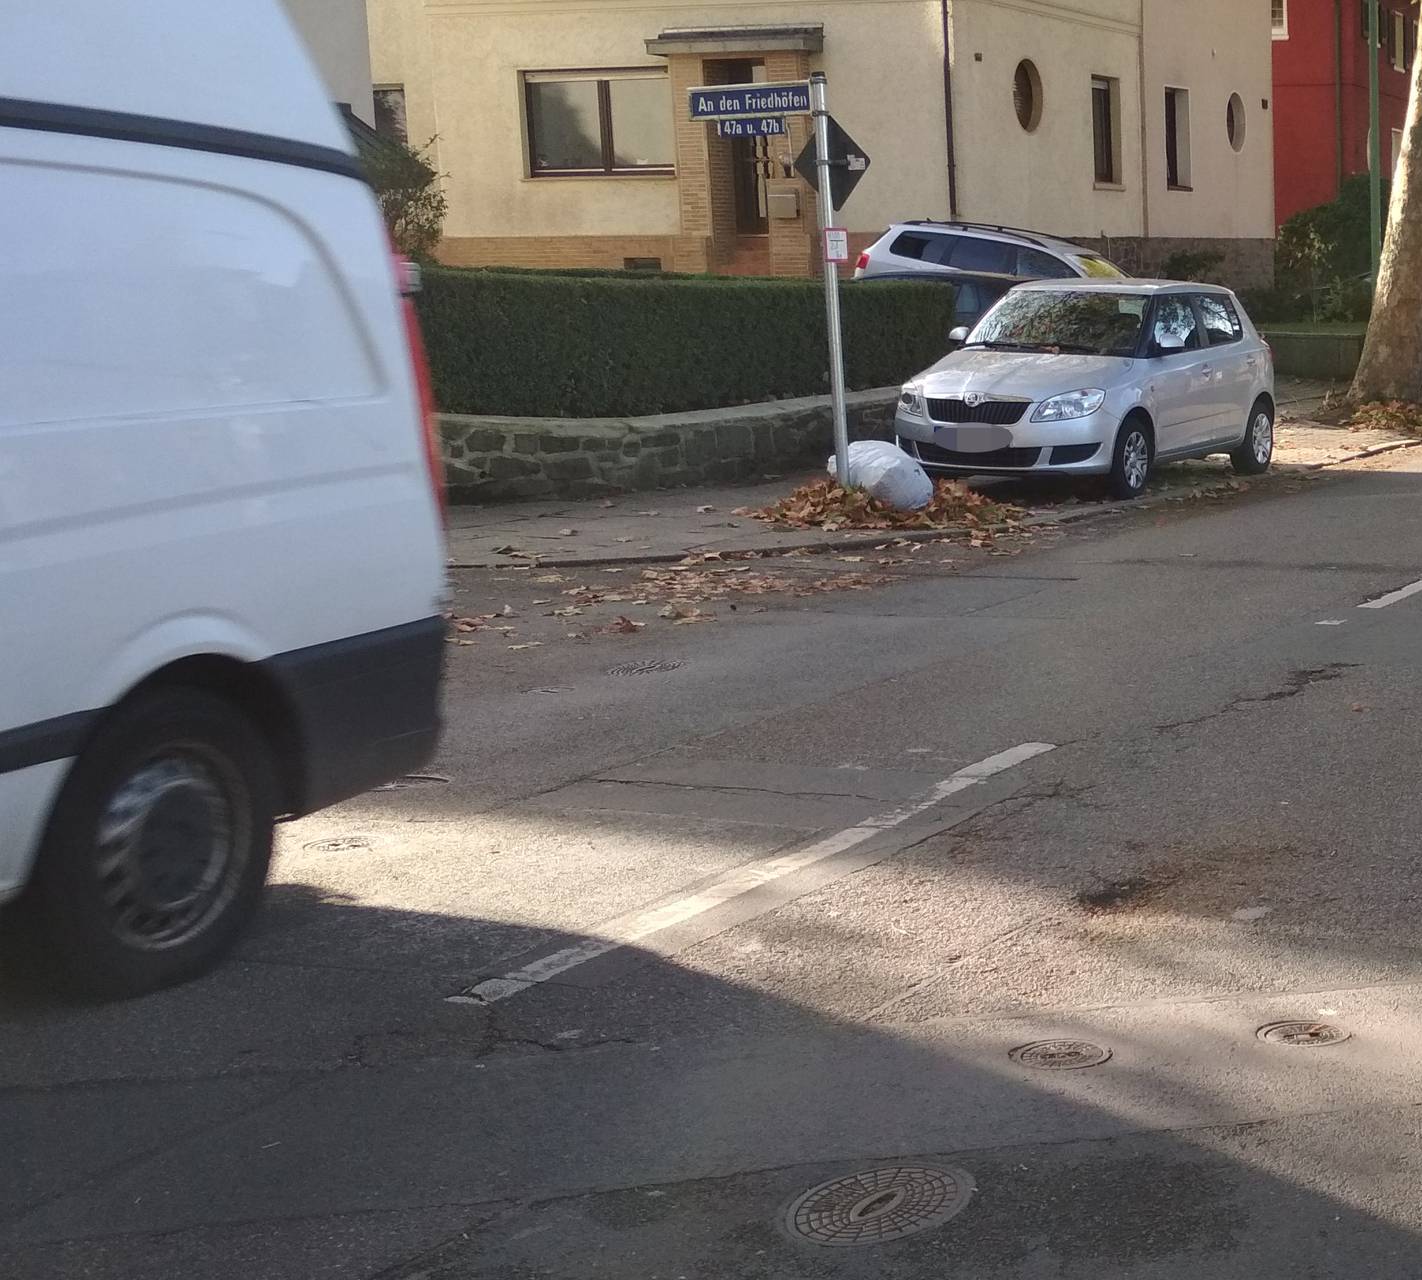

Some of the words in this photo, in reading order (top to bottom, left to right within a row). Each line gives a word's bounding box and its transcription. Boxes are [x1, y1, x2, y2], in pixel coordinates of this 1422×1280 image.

[698, 96, 714, 112] An
[719, 97, 740, 111] den
[745, 91, 807, 109] Friedhöfen
[724, 120, 742, 134] 47a
[747, 122, 757, 134] u.
[761, 118, 780, 133] 47b
